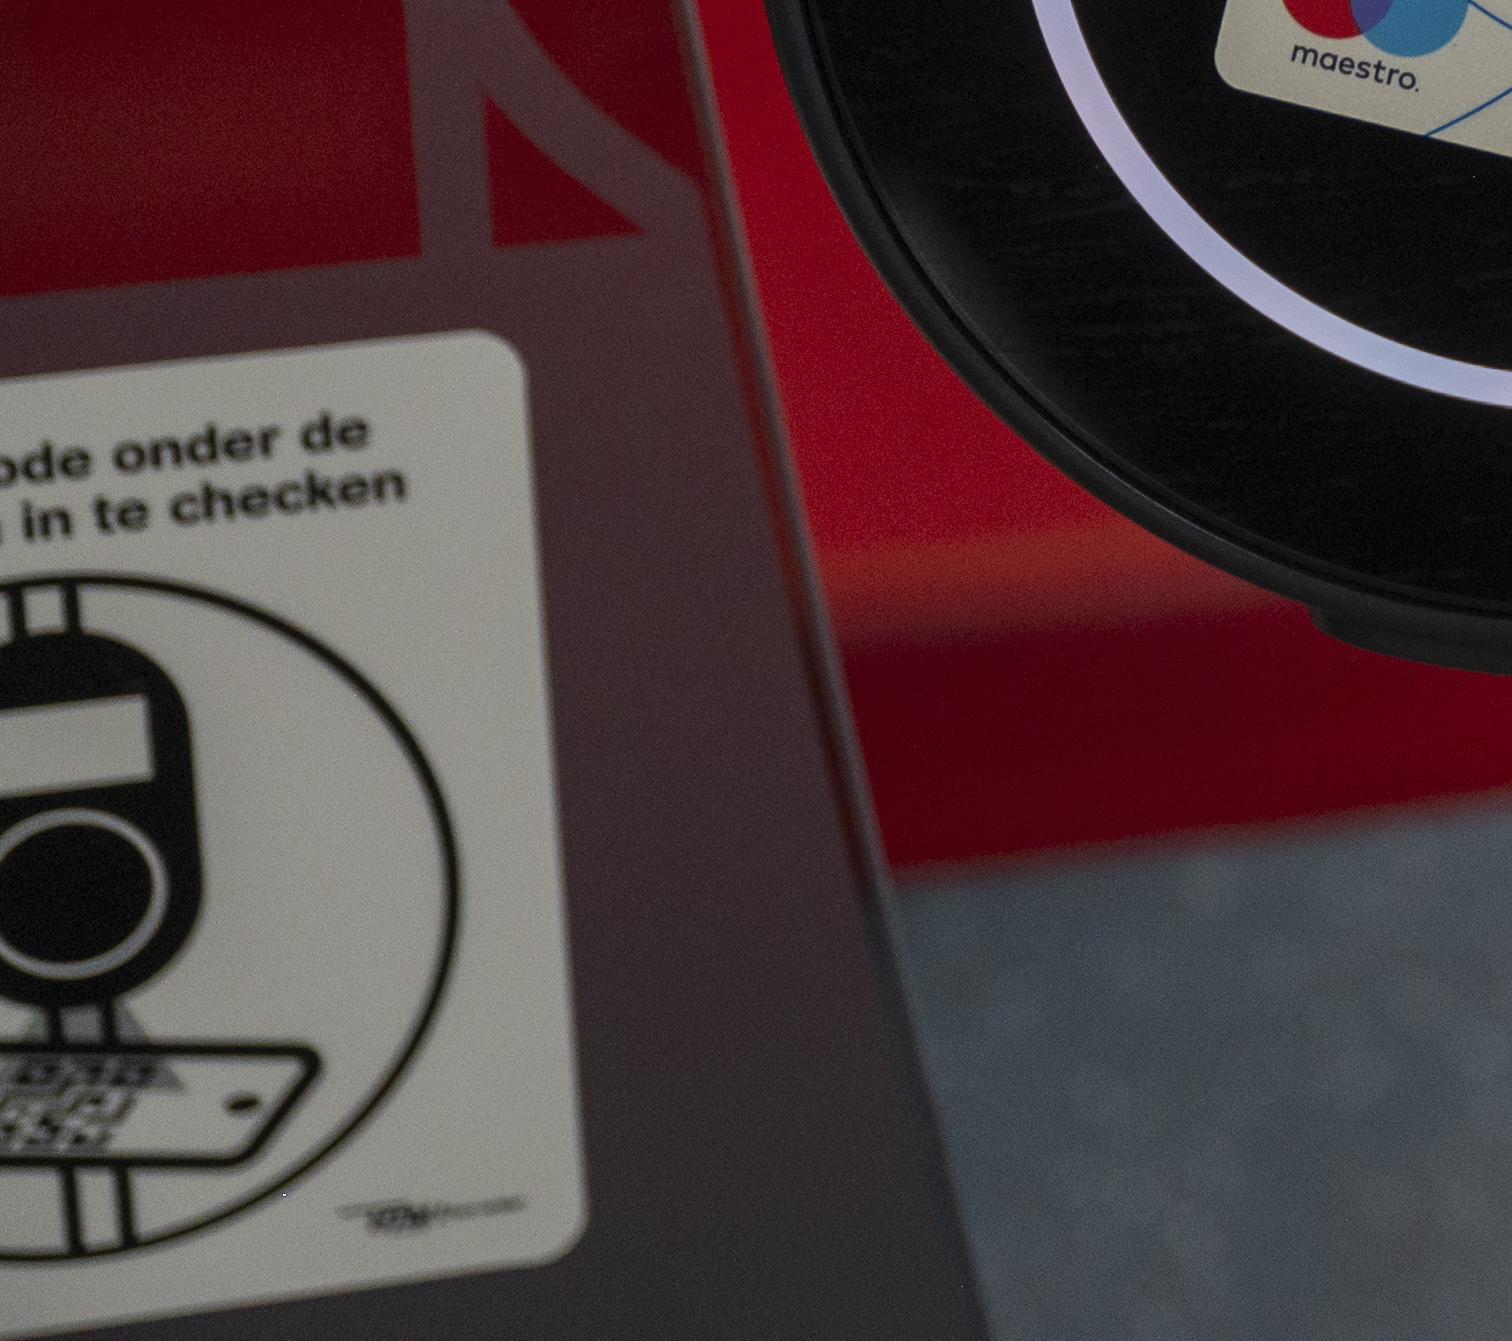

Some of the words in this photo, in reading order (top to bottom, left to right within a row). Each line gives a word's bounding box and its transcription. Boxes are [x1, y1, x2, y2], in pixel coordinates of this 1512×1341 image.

[112, 422, 284, 475] onder
[300, 409, 371, 455] de
[20, 499, 74, 543] in
[93, 496, 150, 536] te
[169, 468, 408, 526] checken
